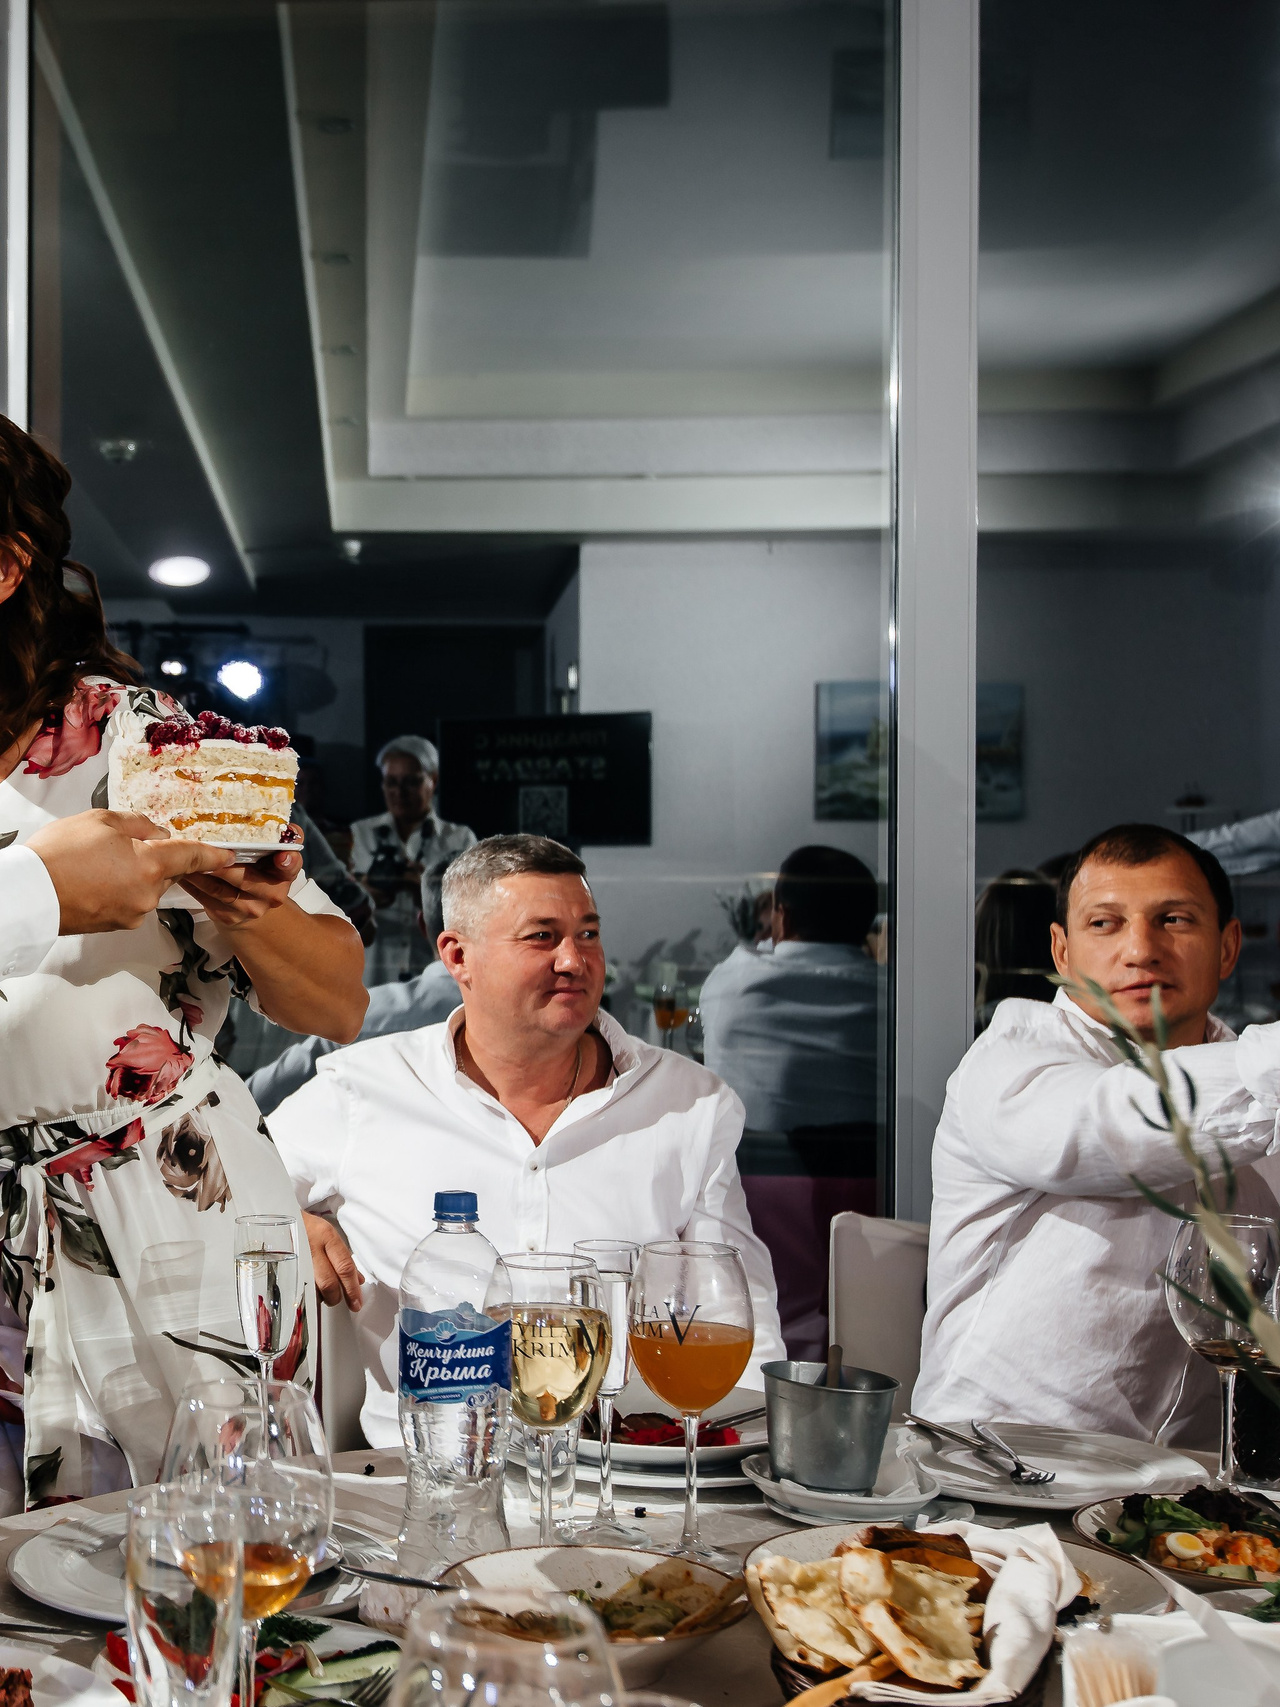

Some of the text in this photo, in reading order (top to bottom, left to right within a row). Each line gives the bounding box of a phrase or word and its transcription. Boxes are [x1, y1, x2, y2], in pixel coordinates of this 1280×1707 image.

[516, 1321, 572, 1338] VILLA
[663, 1301, 702, 1346] V
[406, 1342, 495, 1364] Жемчужина
[513, 1339, 577, 1359] KRIM
[410, 1359, 492, 1387] Крыма
